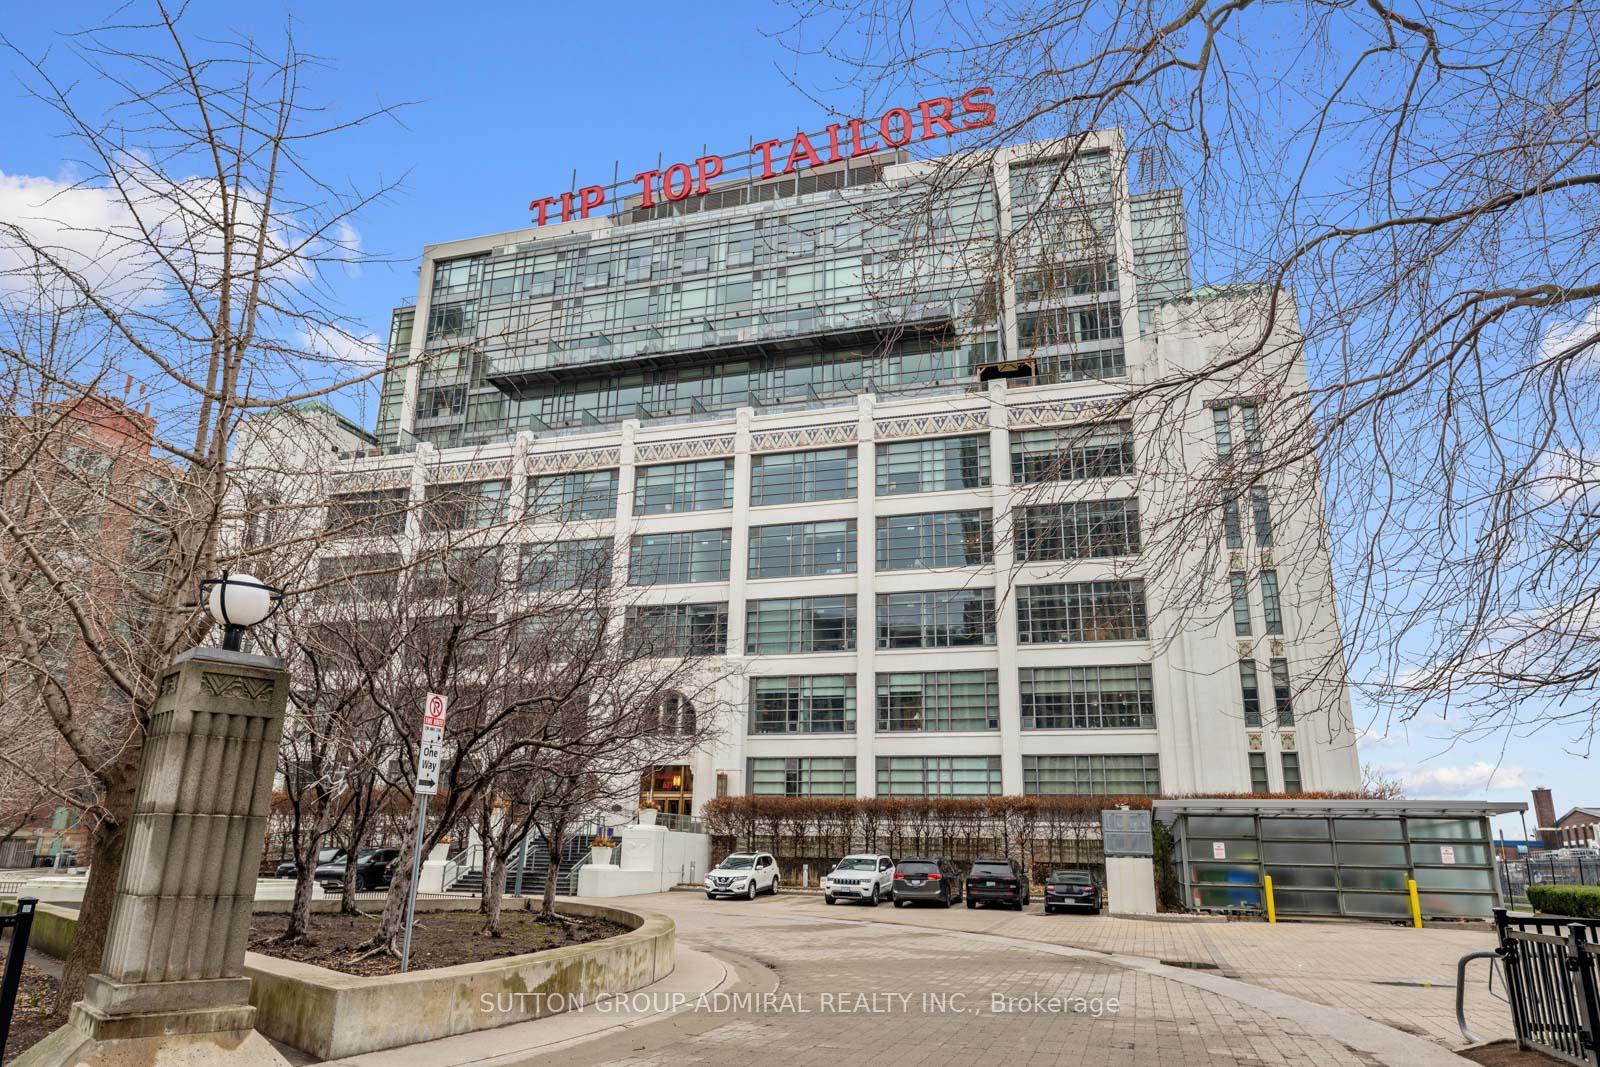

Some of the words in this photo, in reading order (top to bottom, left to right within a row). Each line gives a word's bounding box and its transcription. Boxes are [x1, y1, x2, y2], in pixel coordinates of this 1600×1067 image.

[529, 185, 606, 227] TIP
[633, 155, 724, 210] TOP
[751, 86, 997, 180] TAILORS
[423, 747, 438, 758] One
[422, 760, 437, 773] Way
